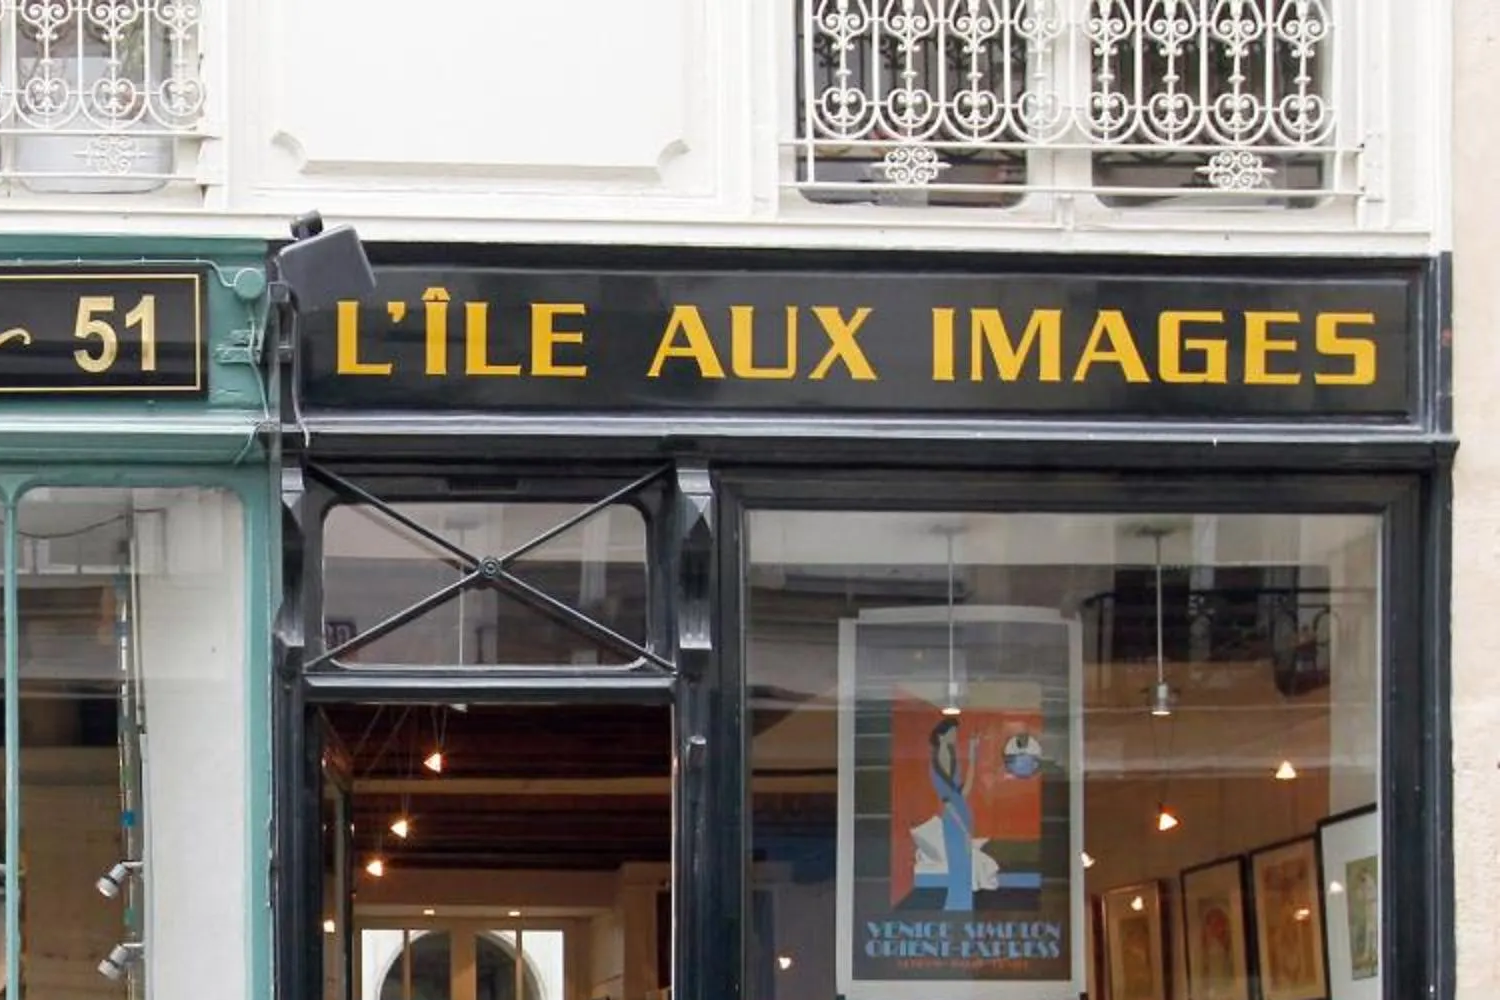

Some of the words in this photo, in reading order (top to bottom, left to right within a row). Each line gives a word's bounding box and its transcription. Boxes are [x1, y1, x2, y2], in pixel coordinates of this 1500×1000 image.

[74, 295, 157, 374] 51
[336, 286, 588, 377] L'ÎLE
[645, 304, 878, 381] AUX
[931, 307, 1377, 386] IMAGES
